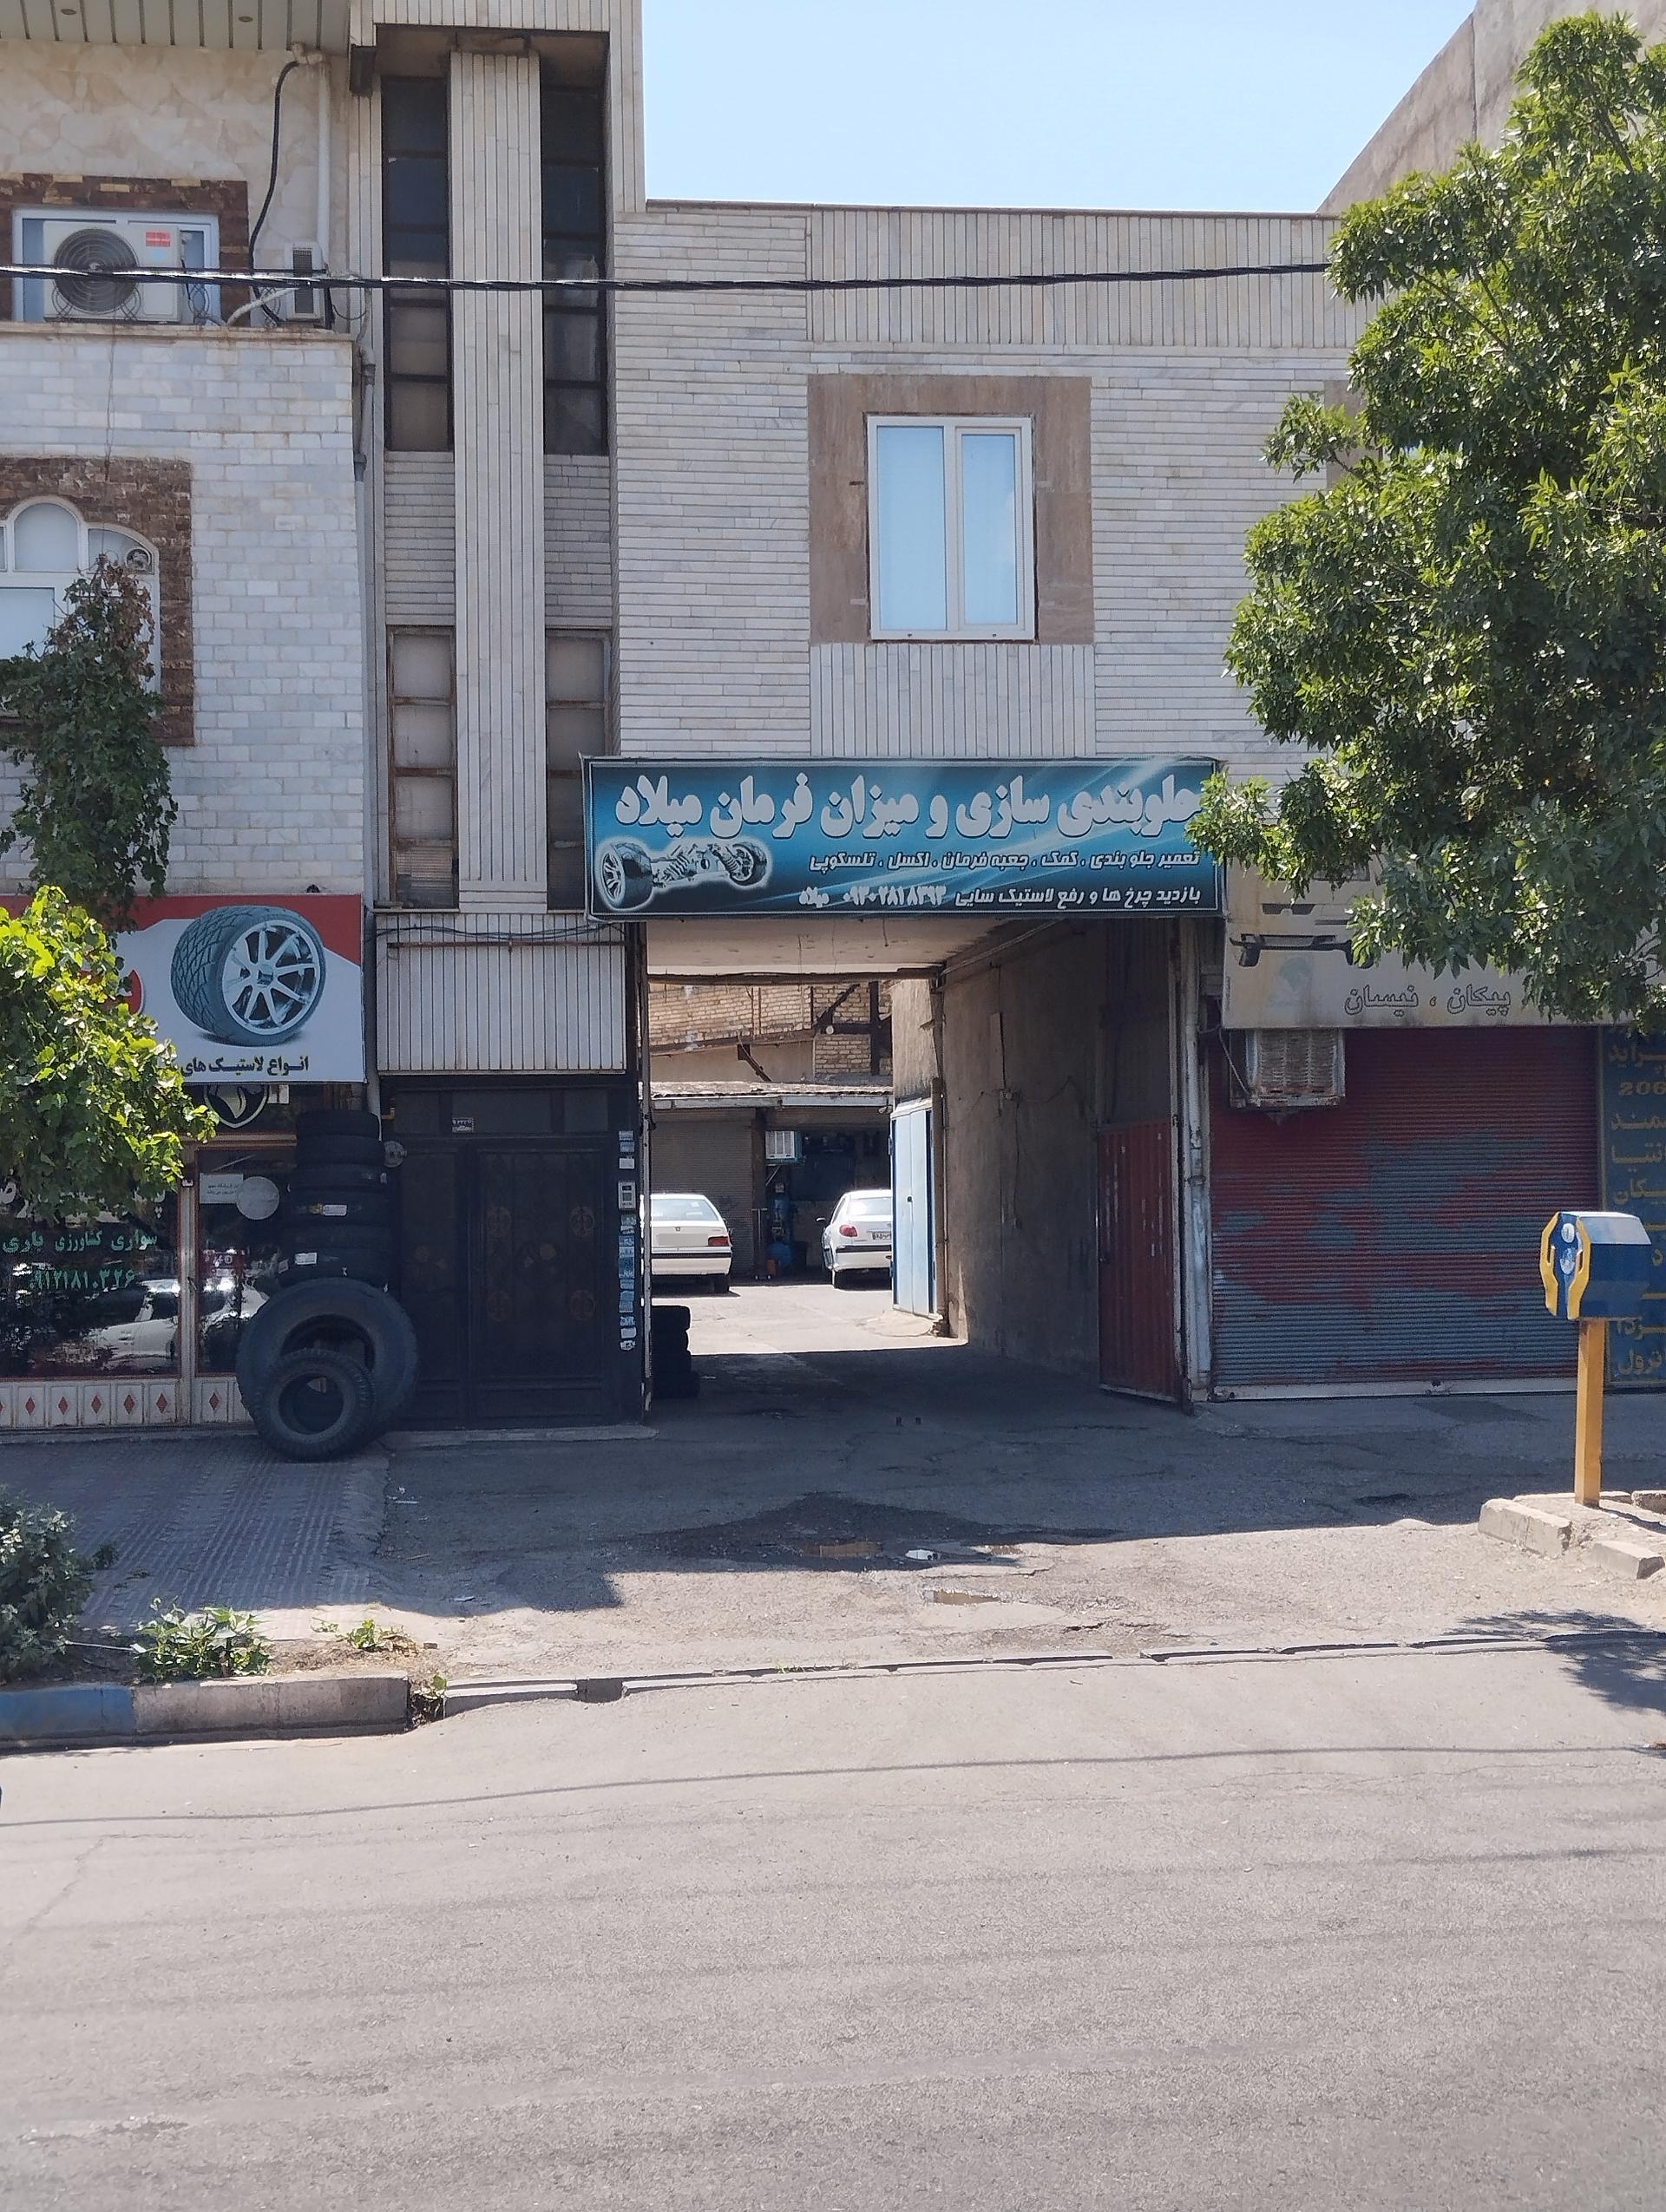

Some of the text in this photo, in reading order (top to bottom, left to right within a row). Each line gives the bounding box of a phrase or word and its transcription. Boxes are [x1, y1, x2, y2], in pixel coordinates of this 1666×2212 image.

[615, 775, 703, 838] میلاد
[710, 771, 814, 839] فرمان
[821, 774, 920, 838] میزان
[955, 775, 1050, 838] سازی
[925, 795, 949, 838] و
[809, 852, 876, 874] تلسکوپی
[888, 852, 930, 870] اکسل
[941, 851, 988, 870] فرمان
[990, 852, 1029, 871] جعبه
[1041, 850, 1079, 867] کمک
[1091, 853, 1126, 869] بندی
[1129, 851, 1155, 869] جلو
[1158, 851, 1201, 868] تعمیر
[954, 886, 994, 907] سایی
[998, 886, 1053, 904] لاستیک
[1057, 887, 1085, 909] رفع
[1089, 890, 1098, 904] و
[1102, 888, 1122, 904] ها
[1125, 887, 1151, 908] چرخ
[1156, 886, 1202, 905] بازدید
[1345, 984, 1419, 1018] نیسان
[1447, 984, 1512, 1017] پیکان
[180, 1055, 310, 1077] انواع لاستیک های
[111, 1229, 158, 1252] سواری
